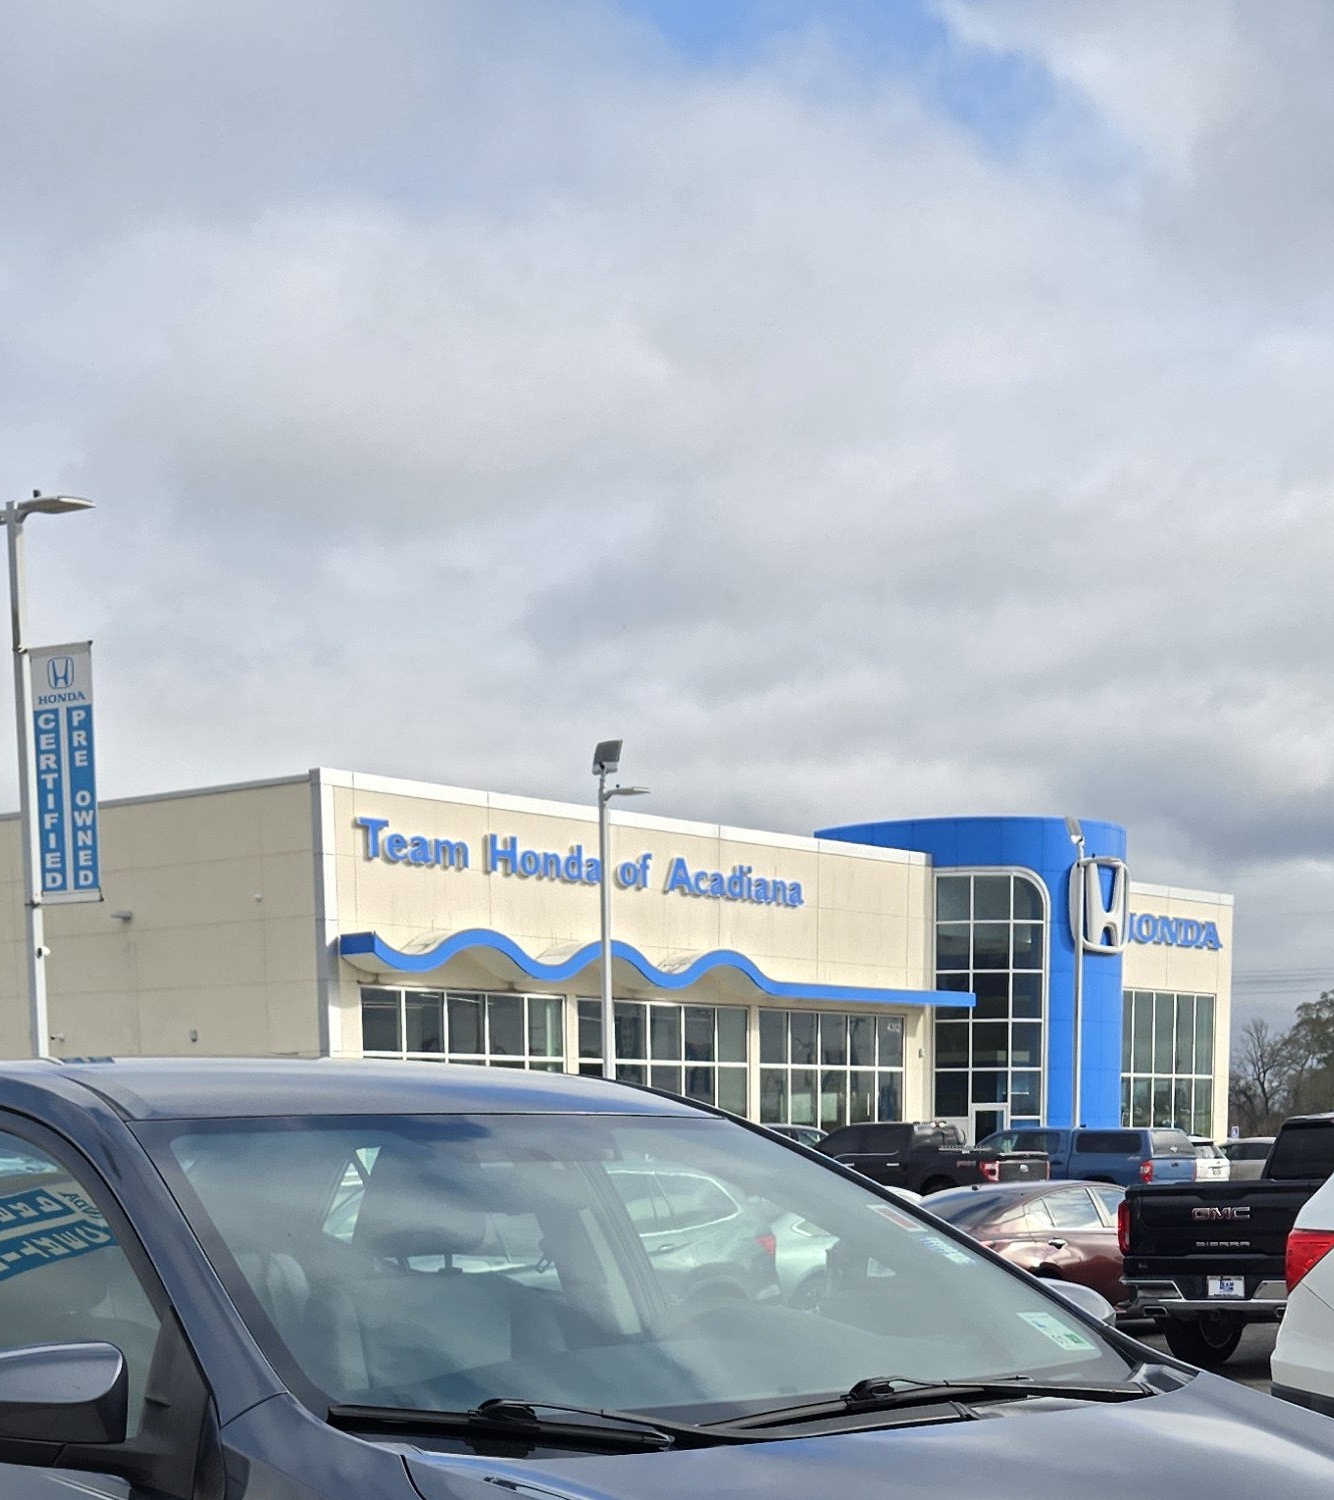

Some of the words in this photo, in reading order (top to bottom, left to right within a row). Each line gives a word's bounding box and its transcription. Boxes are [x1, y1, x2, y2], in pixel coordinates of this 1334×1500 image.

[37, 690, 86, 706] HONDA
[71, 709, 89, 767] PRE
[37, 712, 64, 889] CERTIFIED
[73, 790, 95, 887] OWNED
[356, 815, 470, 869] Team
[487, 833, 602, 885] Honda
[619, 852, 653, 888] of
[667, 857, 805, 907] Acadiana
[1191, 1206, 1251, 1220] GMC
